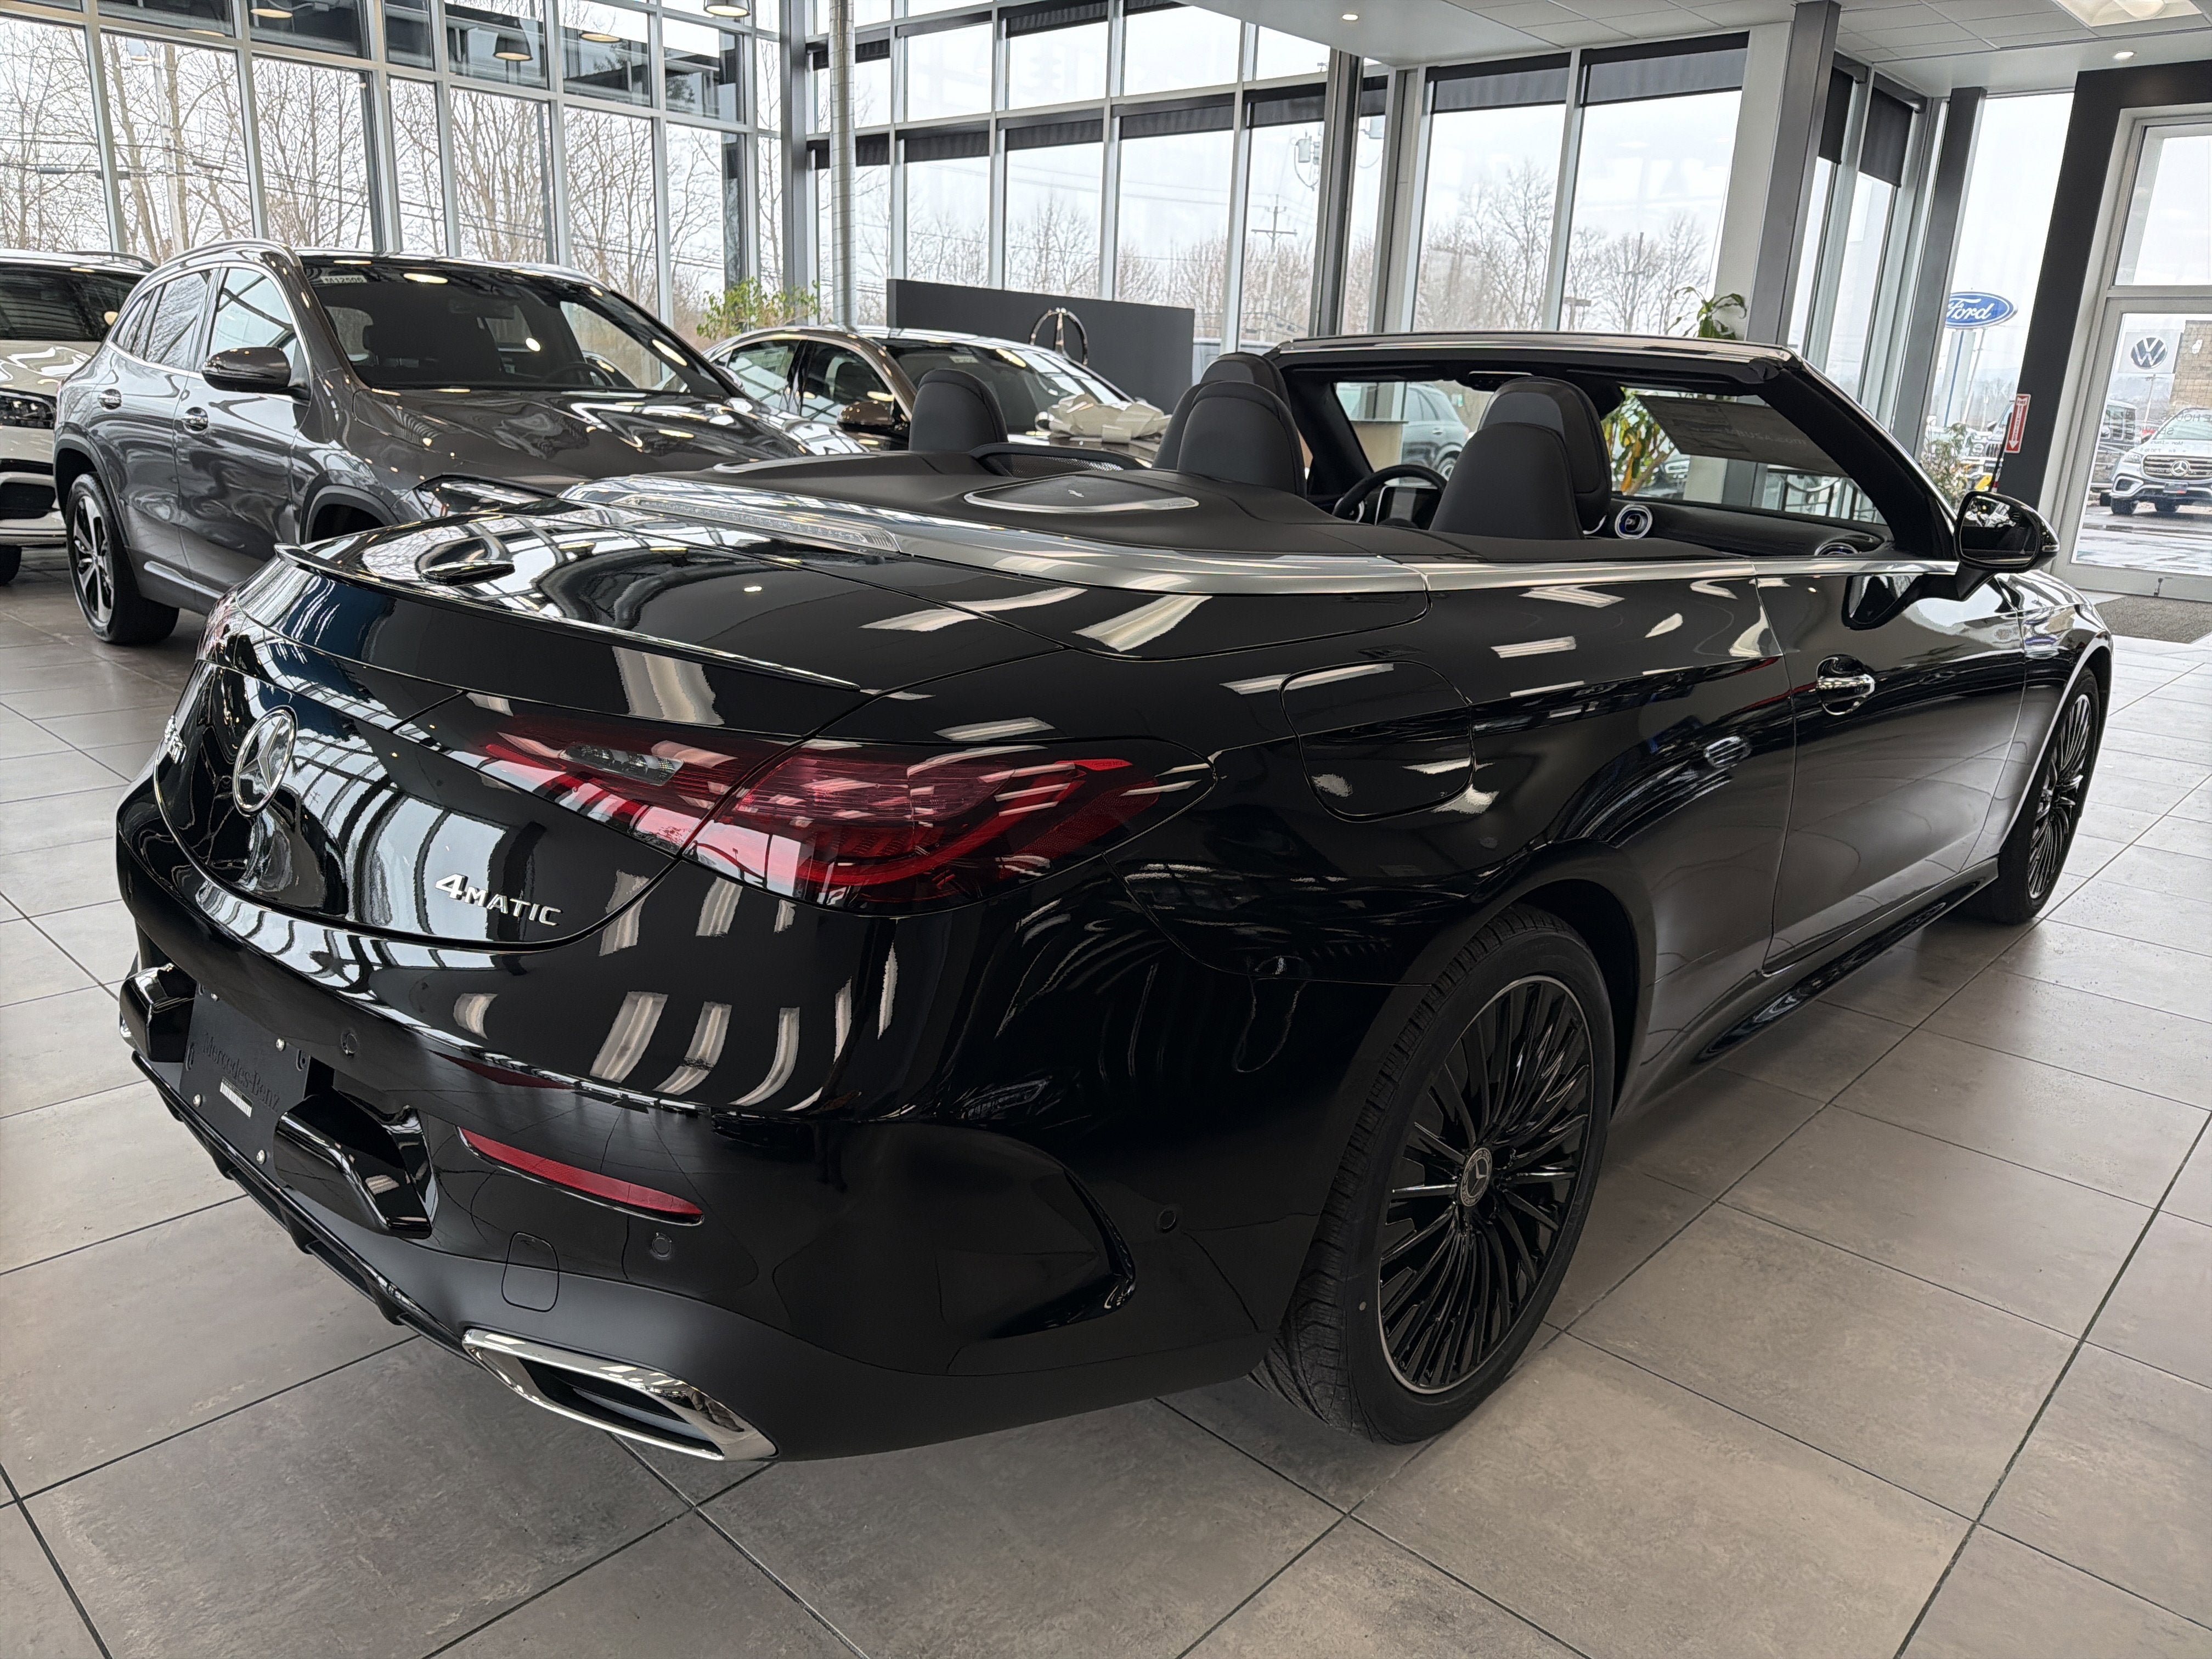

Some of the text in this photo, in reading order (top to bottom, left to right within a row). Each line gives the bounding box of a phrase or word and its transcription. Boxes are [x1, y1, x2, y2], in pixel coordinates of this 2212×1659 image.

[1947, 298, 1995, 319] Ford
[435, 873, 562, 926] 4MATIC
[203, 1031, 280, 1112] Mercedes-Benz
